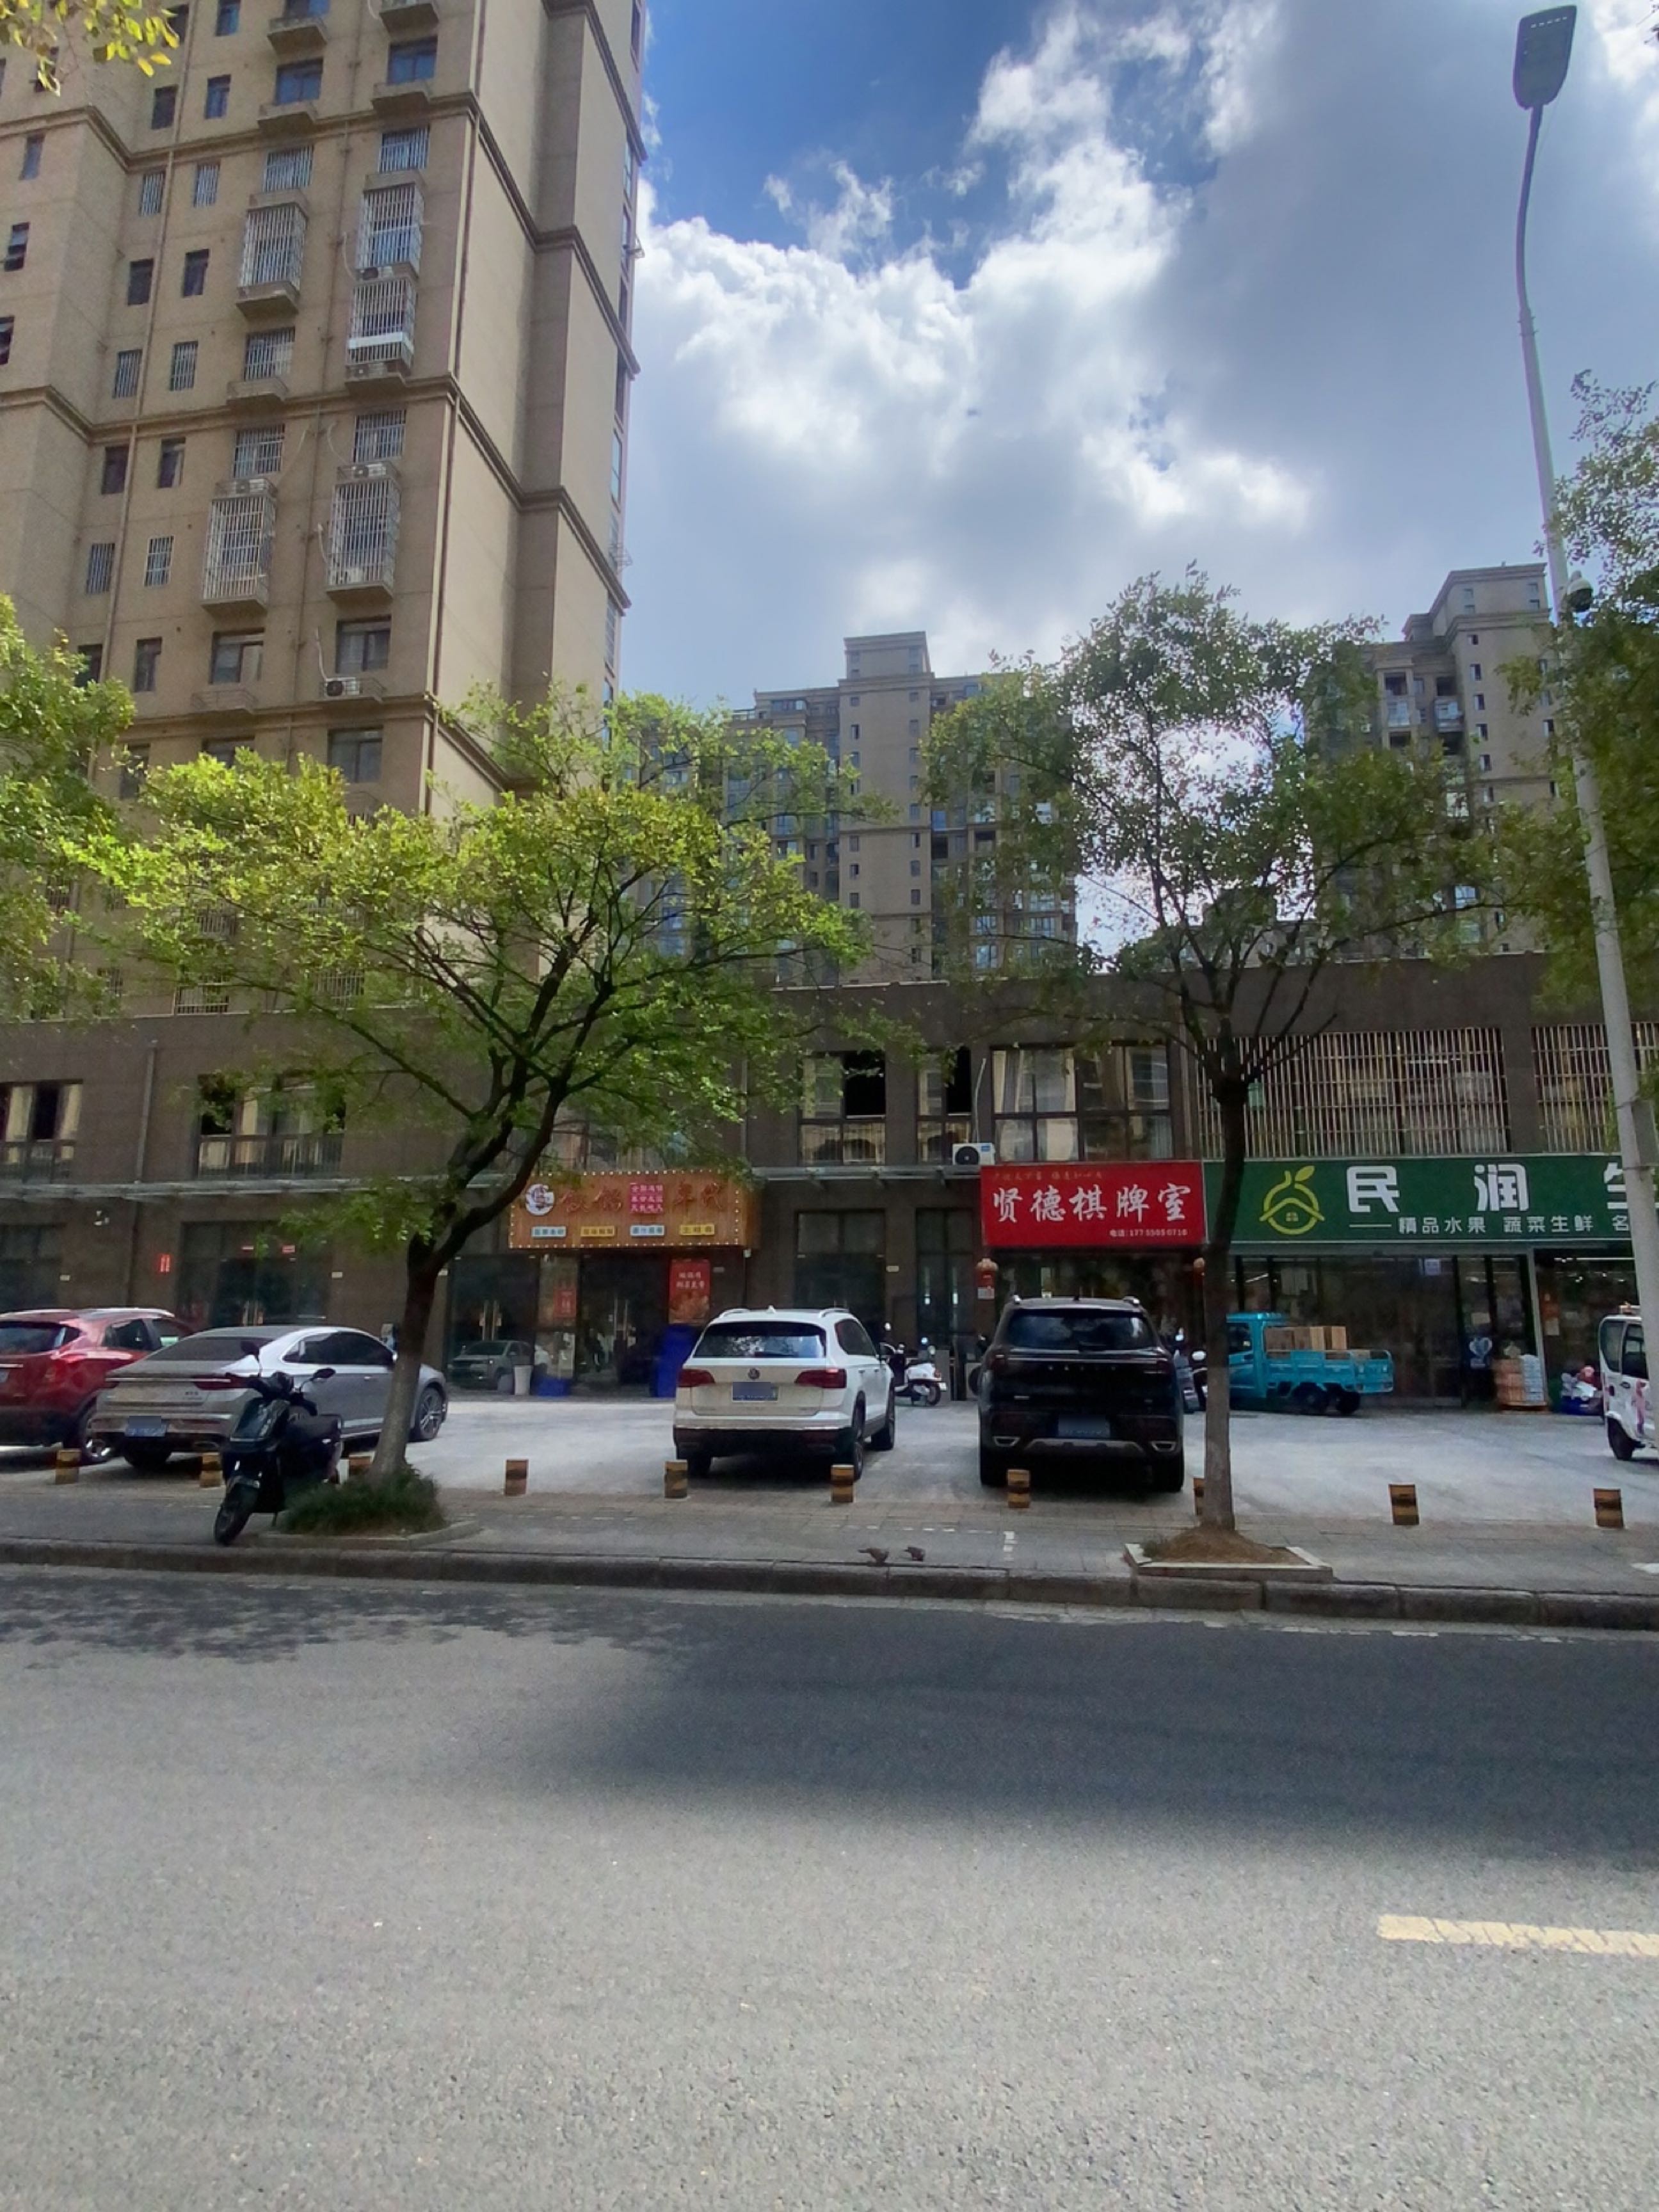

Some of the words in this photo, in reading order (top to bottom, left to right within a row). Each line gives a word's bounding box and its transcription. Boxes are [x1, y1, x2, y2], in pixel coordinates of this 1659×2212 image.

[993, 1183, 1191, 1224] 贤德棋牌室
[1398, 1215, 1486, 1234] 精品水果
[1503, 1215, 1594, 1233] 蔬菜生鲜
